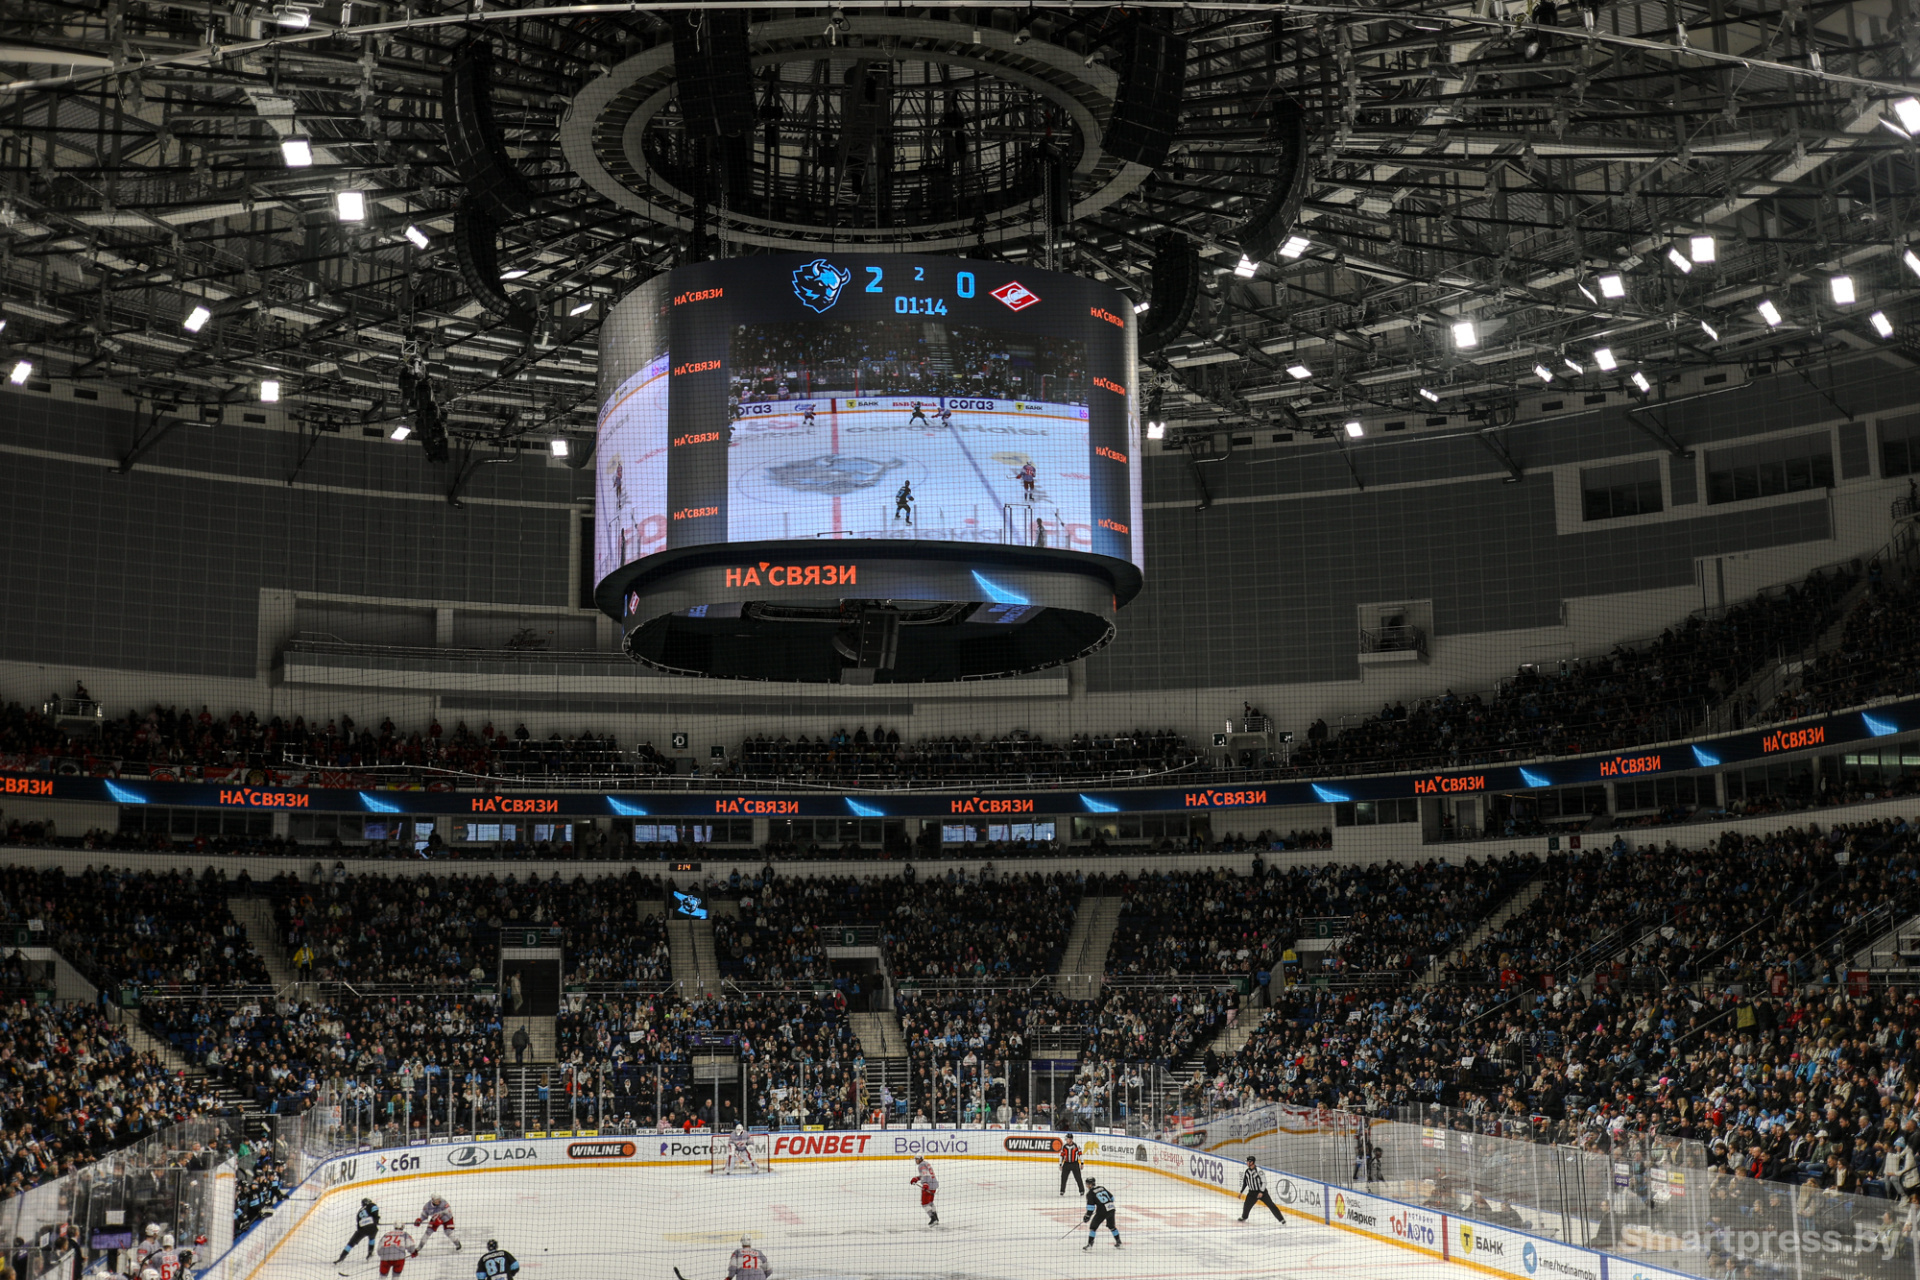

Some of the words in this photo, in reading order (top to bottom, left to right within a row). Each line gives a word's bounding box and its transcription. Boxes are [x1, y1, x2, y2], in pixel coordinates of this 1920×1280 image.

[866, 267, 883, 293] 2
[914, 267, 924, 281] 2
[957, 272, 976, 299] 0
[895, 296, 948, 316] 01:14
[737, 404, 772, 416] огаз
[571, 1144, 622, 1156] WINLINE
[775, 1135, 872, 1155] FONBET
[894, 1134, 968, 1154] Belavia
[1008, 1139, 1052, 1150] WINLINE
[1101, 1145, 1135, 1155] GISLAVED
[493, 1147, 538, 1161] LADA
[1189, 1154, 1224, 1185] согаз
[1299, 1188, 1322, 1208] LADA
[1346, 1208, 1377, 1227] Маркет
[383, 1235, 402, 1248] 24
[1475, 1236, 1504, 1256] БАНК
[485, 1256, 506, 1277] 87
[743, 1254, 758, 1270] 21
